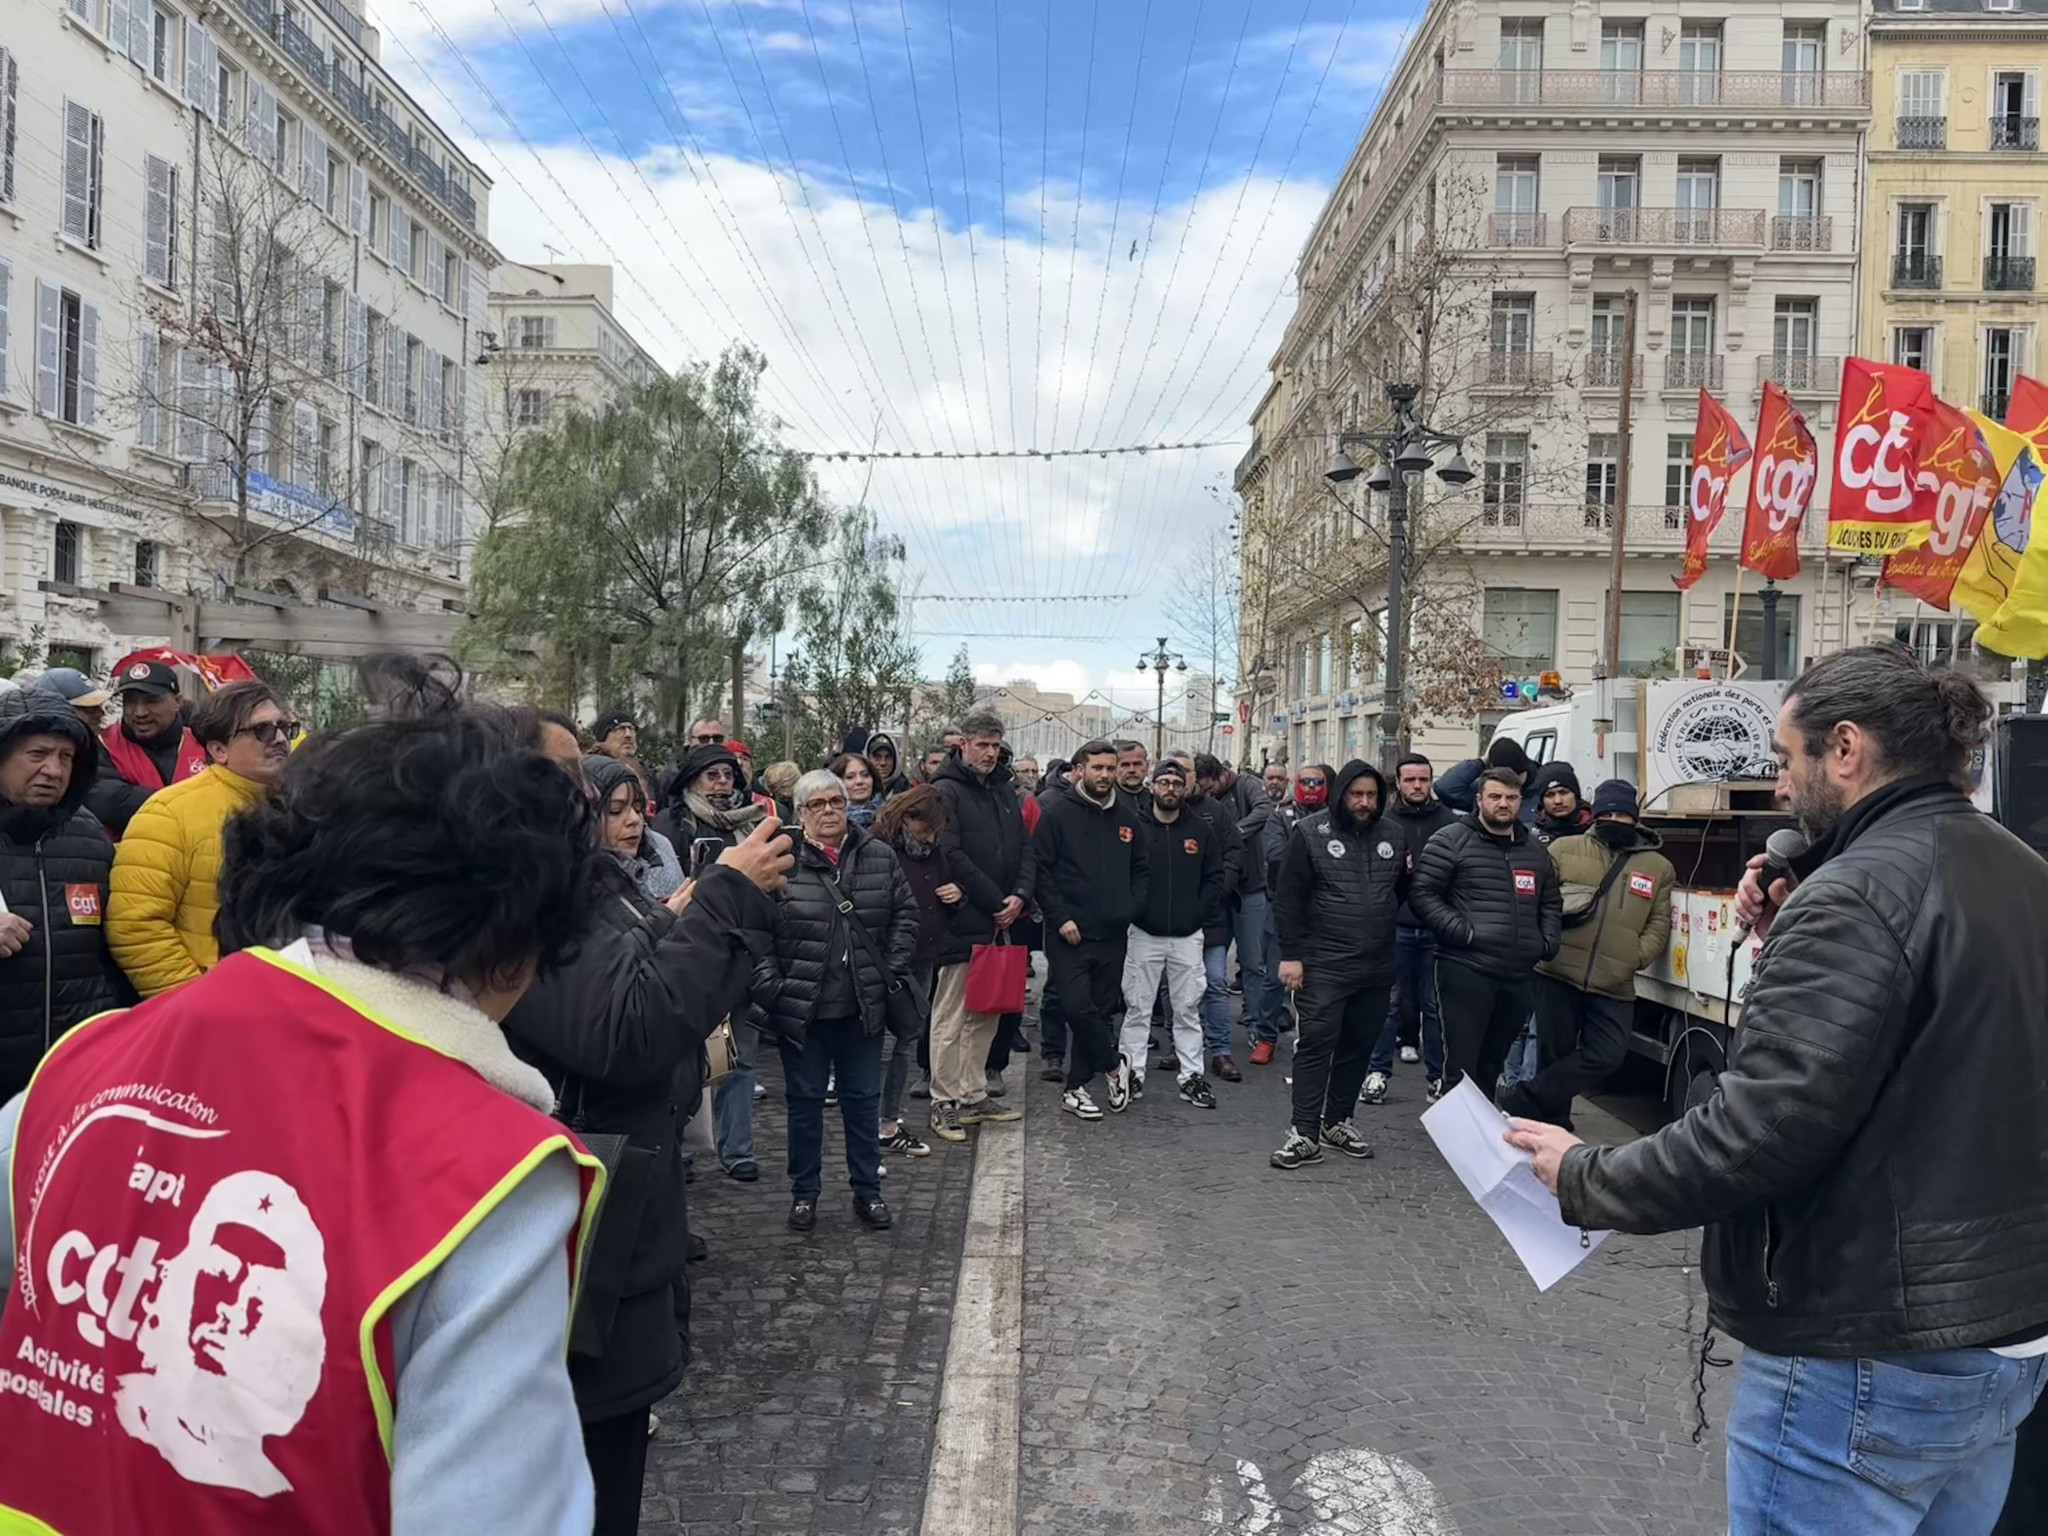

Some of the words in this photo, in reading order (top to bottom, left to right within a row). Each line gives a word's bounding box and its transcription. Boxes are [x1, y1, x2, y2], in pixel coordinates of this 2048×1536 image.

[0, 474, 38, 494] BANQUE
[39, 485, 87, 507] POPULAIRE
[1756, 454, 1816, 533] cgt
[1874, 531, 1890, 550] DU
[1657, 707, 1682, 754] Fédération
[1682, 688, 1721, 709] nationale
[1724, 689, 1741, 700] des
[1741, 697, 1764, 714] ports
[1762, 715, 1772, 726] et
[1711, 704, 1726, 712] ET
[71, 893, 98, 915] cgt
